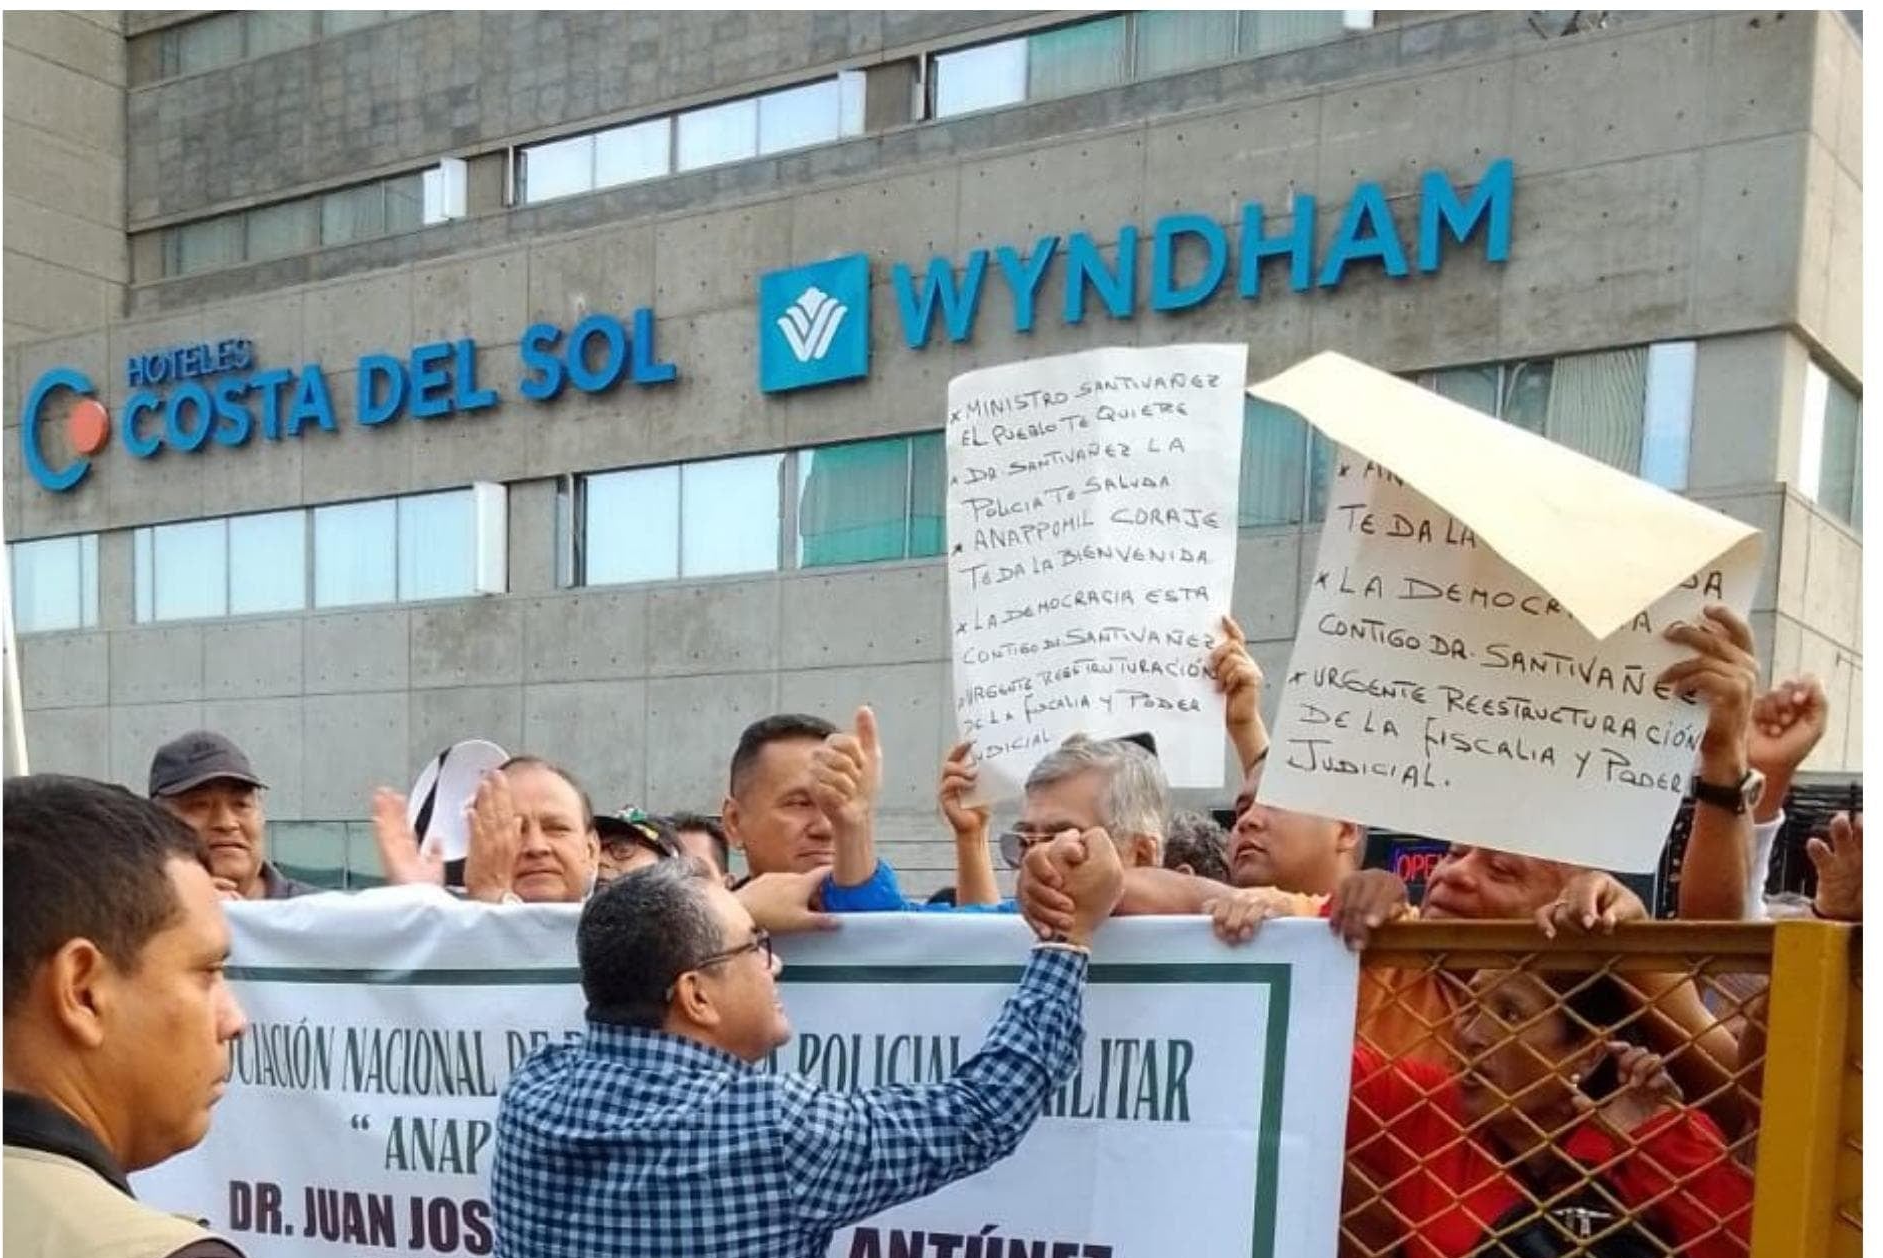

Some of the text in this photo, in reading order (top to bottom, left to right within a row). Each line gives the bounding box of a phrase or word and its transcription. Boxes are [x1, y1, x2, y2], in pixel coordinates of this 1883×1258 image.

[892, 158, 1513, 350] WYNDHAM
[127, 338, 253, 388] HOTELES
[122, 308, 677, 459] COSTA DEL SOL
[967, 389, 1068, 418] MINISTRO
[962, 429, 988, 447] EL
[1148, 437, 1185, 454] LA
[1110, 508, 1221, 529] CORAJE
[1337, 503, 1374, 535] TE
[1386, 513, 1432, 543] DA
[1445, 516, 1477, 549] LA
[1060, 546, 1208, 568] BIENVENIDA
[1339, 566, 1383, 599] LA
[974, 585, 1210, 631] LA DEMOCRACIA ESTA
[1318, 613, 1420, 650] CONTIGO
[1313, 667, 1427, 704] URGENTE
[1298, 703, 1350, 729] DE
[1364, 711, 1399, 737] LA
[1423, 716, 1555, 766] FISCALIA
[1575, 751, 1591, 779] Y
[1397, 854, 1443, 881] OPE
[341, 1026, 498, 1097] NACIONAL
[229, 1180, 294, 1237] DR.
[303, 1186, 397, 1249] JUAN
